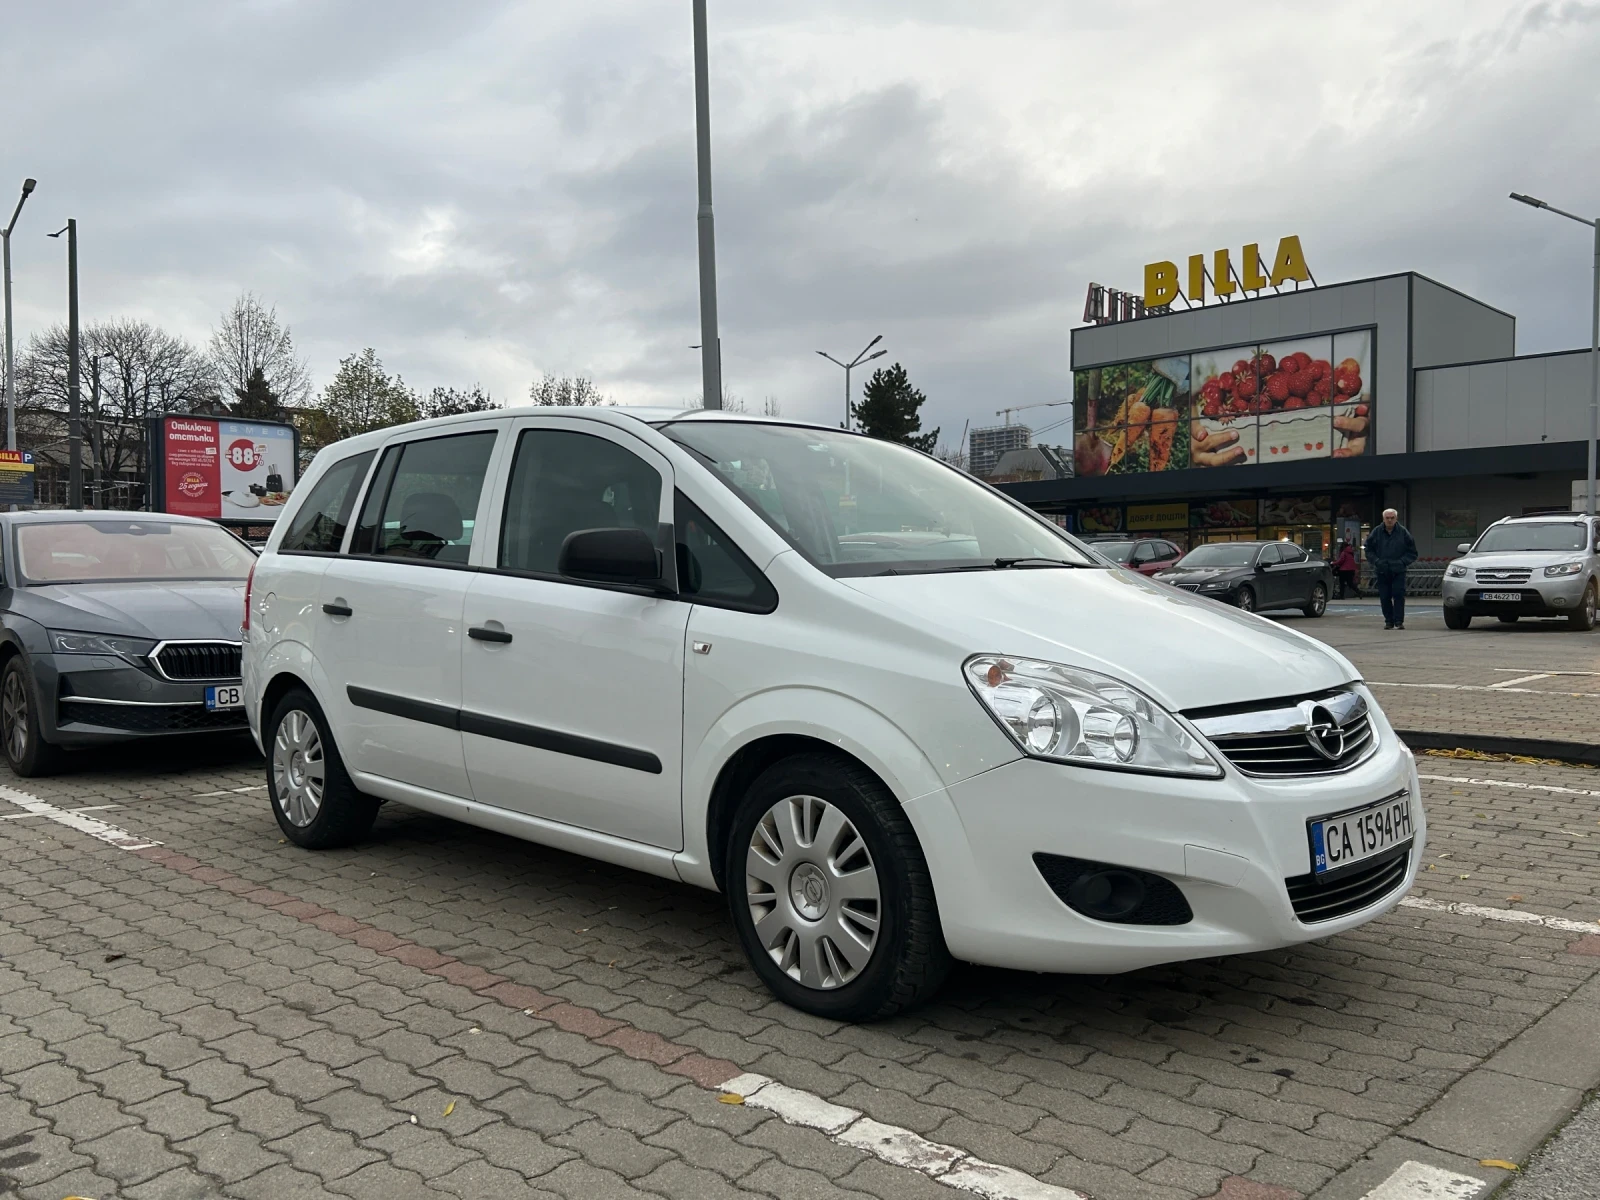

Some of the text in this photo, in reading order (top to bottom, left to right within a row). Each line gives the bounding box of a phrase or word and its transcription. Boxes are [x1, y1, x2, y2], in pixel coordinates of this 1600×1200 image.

[1144, 235, 1310, 307] BILLA
[171, 420, 212, 433] Отключи
[169, 433, 214, 443] отстъпки
[0, 452, 20, 461] ILLA
[1129, 512, 1186, 523] ДОБРЕ ДОШЛИ
[218, 688, 239, 704] CB
[1327, 821, 1354, 862] CA
[1316, 854, 1325, 866] BG
